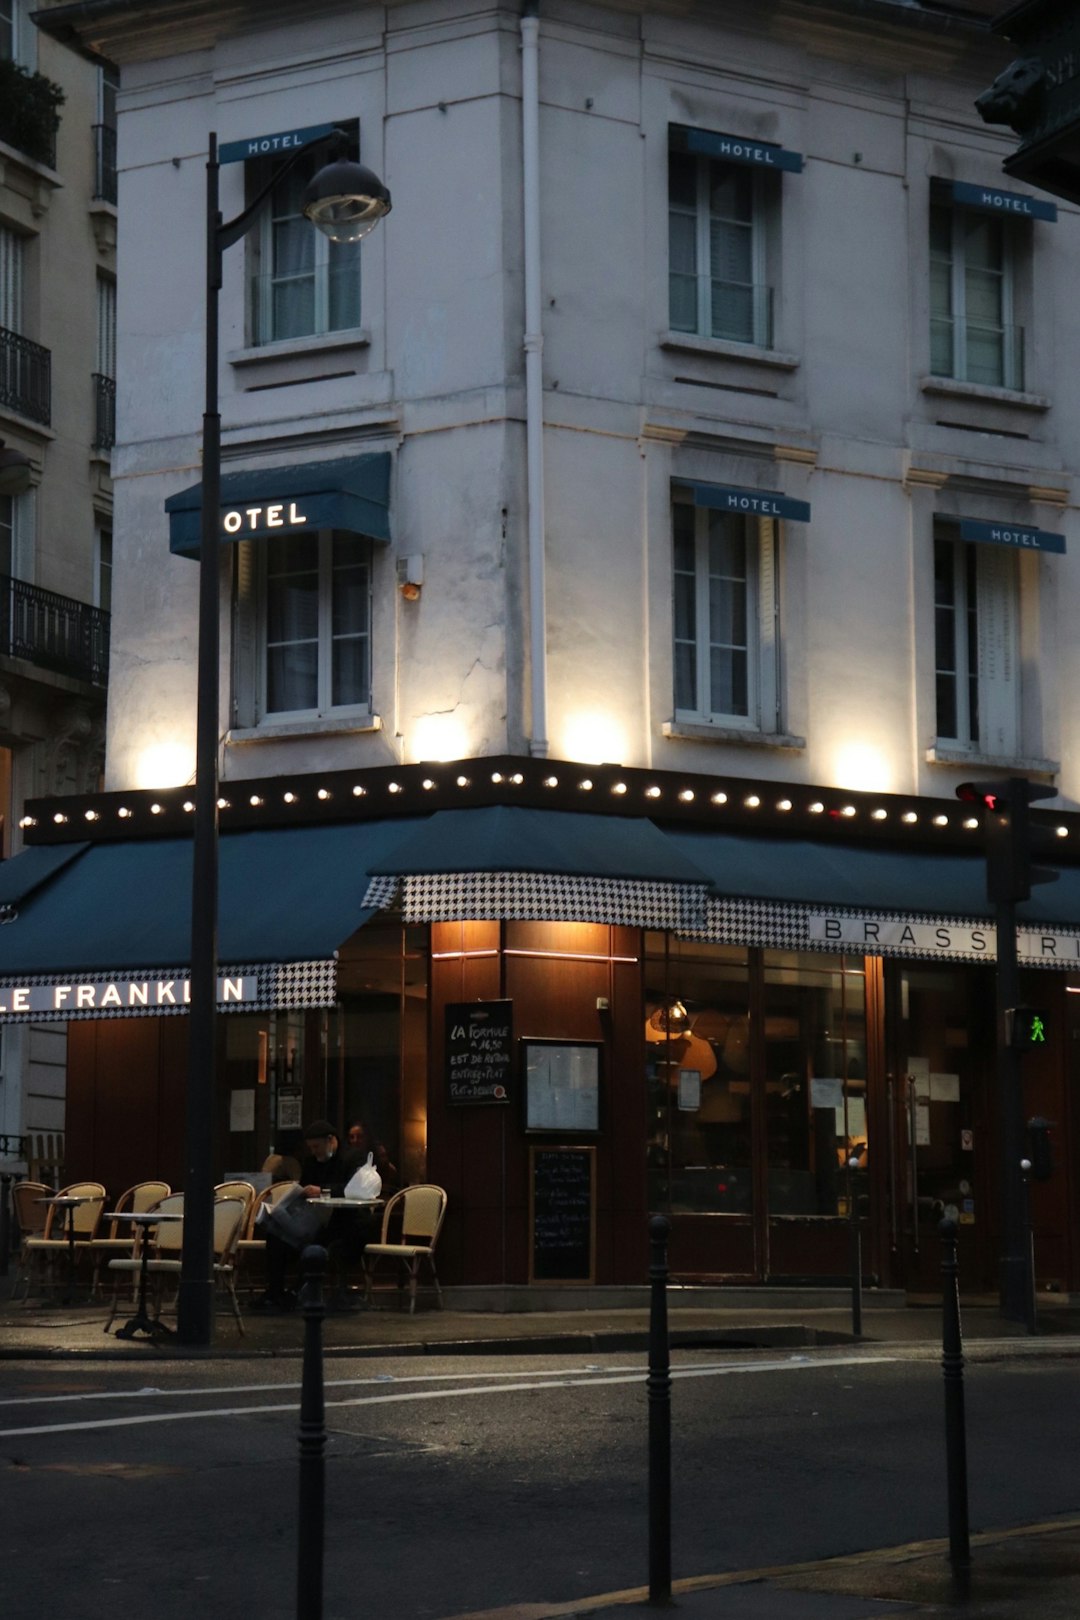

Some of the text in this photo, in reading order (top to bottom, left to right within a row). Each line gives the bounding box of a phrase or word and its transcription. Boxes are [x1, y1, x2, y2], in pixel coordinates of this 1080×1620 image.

[248, 134, 302, 154] HOTEL
[721, 142, 774, 163] HOTEL
[983, 193, 1032, 214] HOTEL
[728, 495, 781, 514] HOTEL
[223, 502, 307, 533] OTEL
[992, 529, 1040, 547] HOTEL
[825, 919, 1080, 958] BRASSRI
[55, 978, 243, 1009] FRANKLN
[451, 1025, 466, 1040] LA
